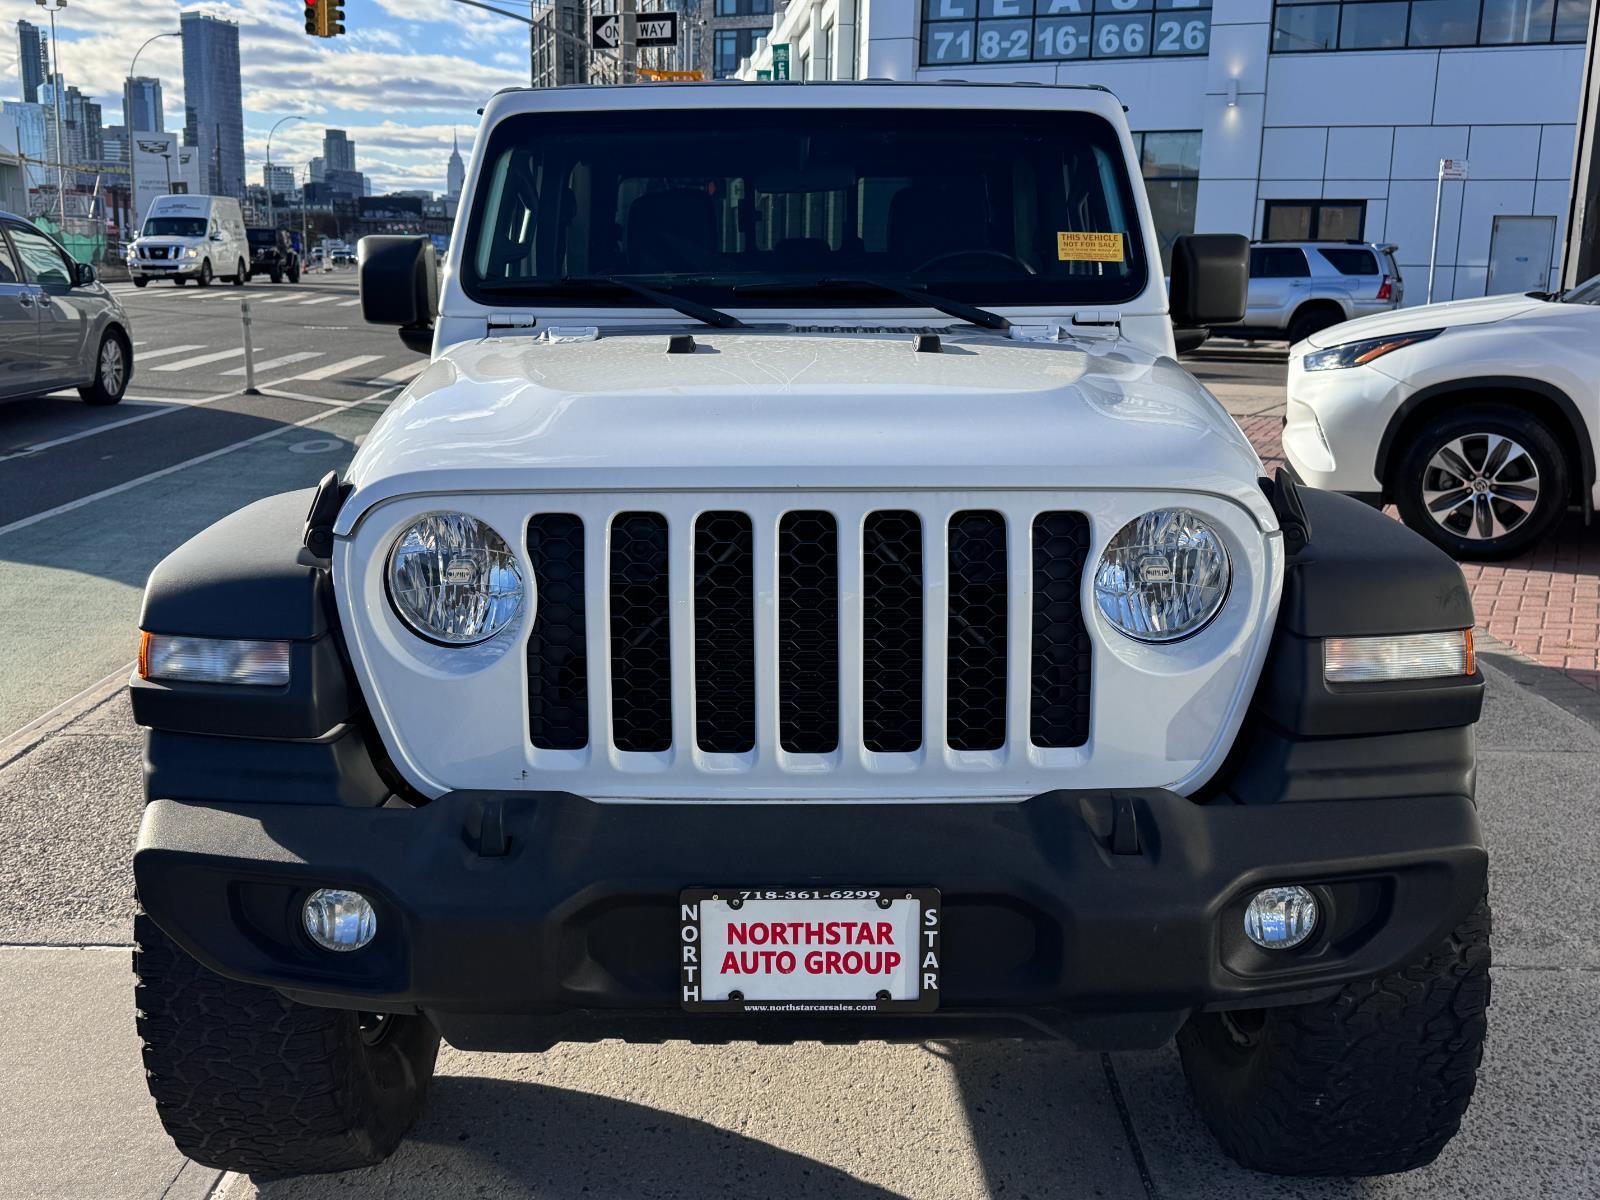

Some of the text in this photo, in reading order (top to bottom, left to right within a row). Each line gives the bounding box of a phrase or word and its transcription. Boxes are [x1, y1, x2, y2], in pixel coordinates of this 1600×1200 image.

[604, 22, 666, 39] ON WAY
[1061, 233, 1080, 241] THIS
[739, 890, 881, 900] 718-361-6299
[727, 922, 895, 945] NORTHSTAR
[681, 904, 699, 1002] NORTH
[922, 908, 939, 990] STAR
[720, 951, 901, 975] AUTO GROUP
[744, 1003, 877, 1012] www.northstarcarsales.com
